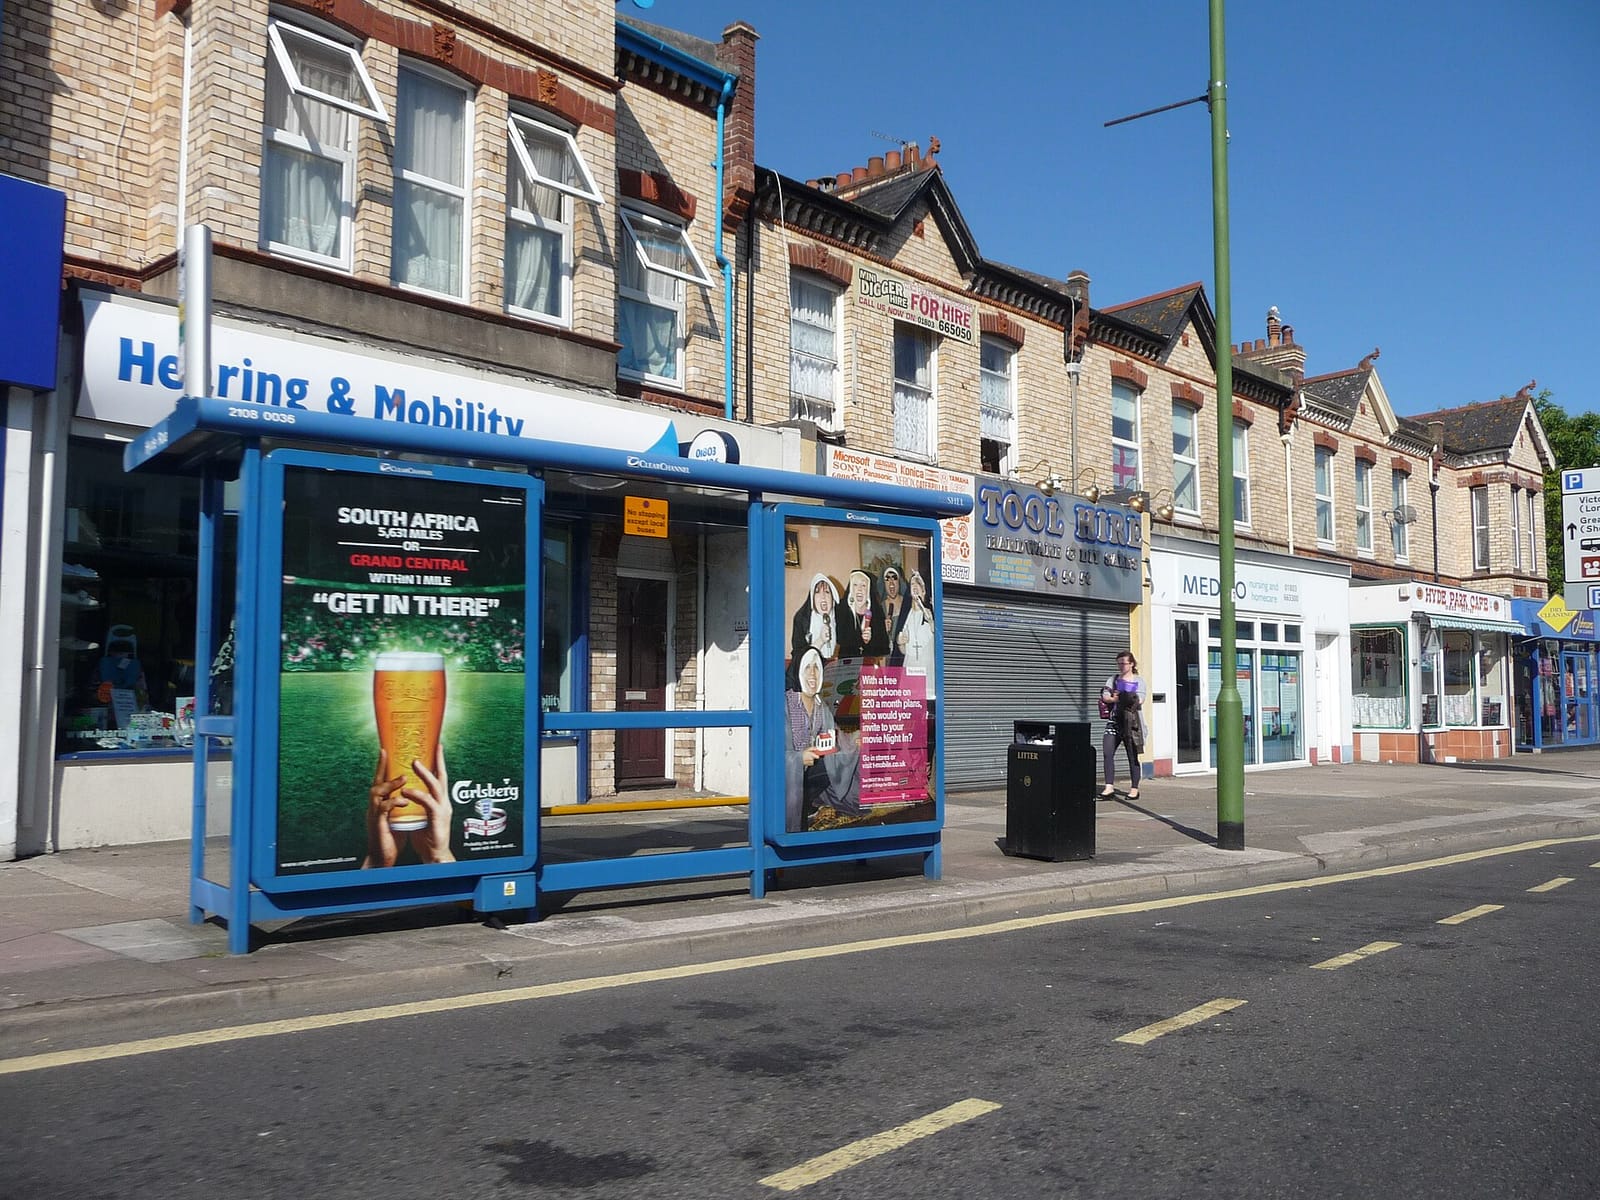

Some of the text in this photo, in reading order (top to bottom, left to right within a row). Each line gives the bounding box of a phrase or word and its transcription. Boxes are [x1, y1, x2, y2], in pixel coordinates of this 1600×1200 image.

[861, 280, 904, 297] DIGGER
[889, 293, 908, 309] HIRE
[911, 293, 971, 328] FOR HIRE
[859, 297, 875, 308] CALL
[877, 303, 885, 312] US
[888, 306, 904, 317] NOW
[906, 312, 915, 321] ON
[939, 320, 972, 341] 665050
[118, 337, 310, 410] Hering
[326, 377, 356, 416] &
[833, 449, 870, 466] Microsoft
[832, 461, 861, 473] SONY
[900, 464, 925, 479] Konica
[863, 469, 893, 481] Panasonic
[338, 507, 480, 532] SOUTH AFRICA
[979, 485, 1143, 551] TOOL HIRE
[377, 526, 444, 540] 5,631 MILES
[402, 541, 420, 551] OR
[350, 554, 469, 571] GRAND CENTRAL
[368, 573, 415, 585] WITHIN
[422, 575, 452, 586] MILE
[1183, 574, 1247, 599] MEDO
[312, 592, 500, 617] “GET IN THERE”
[1425, 587, 1447, 605] HYDE
[1449, 591, 1468, 608] PARK
[1470, 595, 1489, 612] CAFE
[862, 675, 877, 684] With
[884, 675, 897, 685] free
[862, 687, 902, 698] smartphone
[862, 698, 874, 708] £20
[881, 699, 902, 708] month
[862, 710, 876, 719] who
[877, 710, 897, 719] would
[862, 722, 904, 733] invite to your
[862, 733, 882, 743] movie
[883, 733, 901, 744] Night
[1017, 751, 1039, 760] LITTER
[451, 778, 520, 804] Carlsberg
